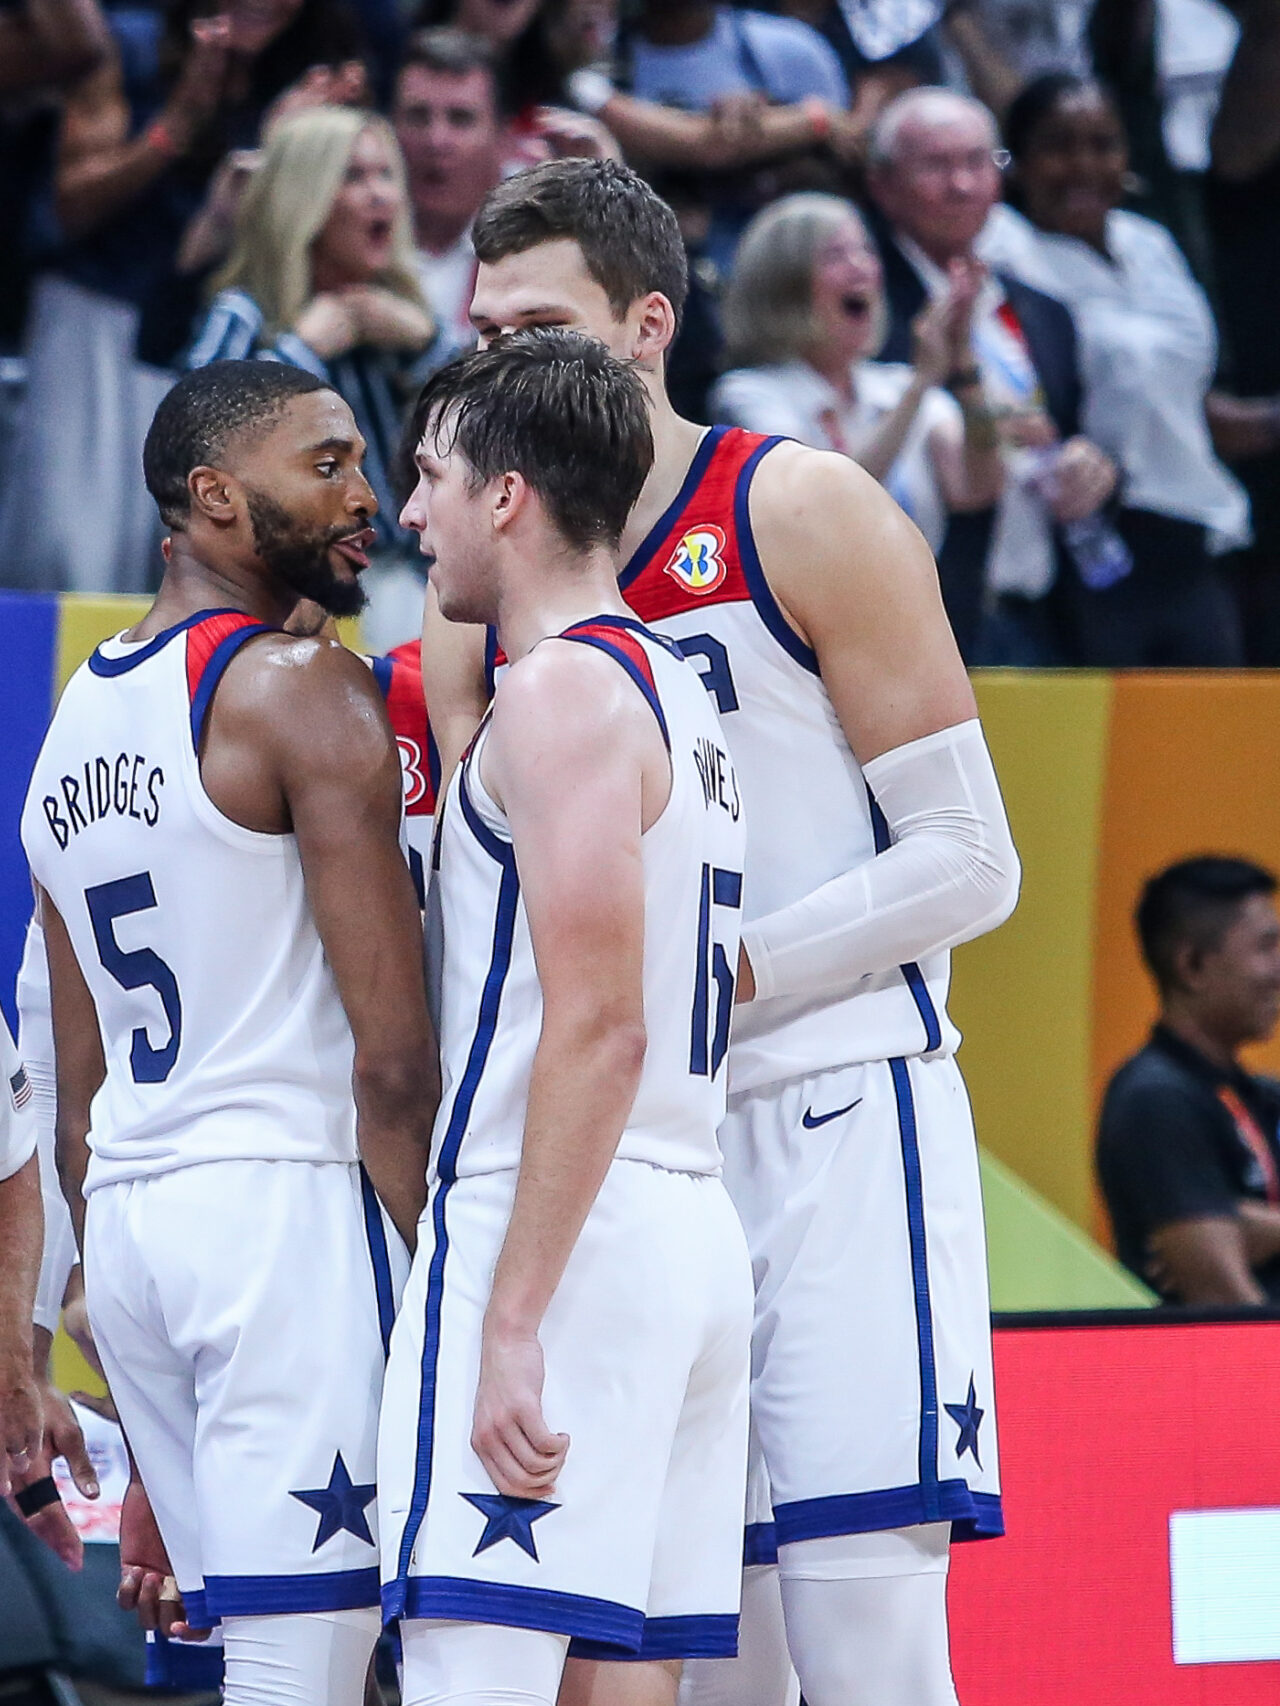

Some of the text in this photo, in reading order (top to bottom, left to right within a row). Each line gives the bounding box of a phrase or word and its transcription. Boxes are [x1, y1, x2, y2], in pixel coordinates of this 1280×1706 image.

[42, 752, 165, 852] BRIDGES
[693, 737, 740, 823] RVES
[84, 870, 183, 1084] 5
[690, 862, 743, 1083] 15
